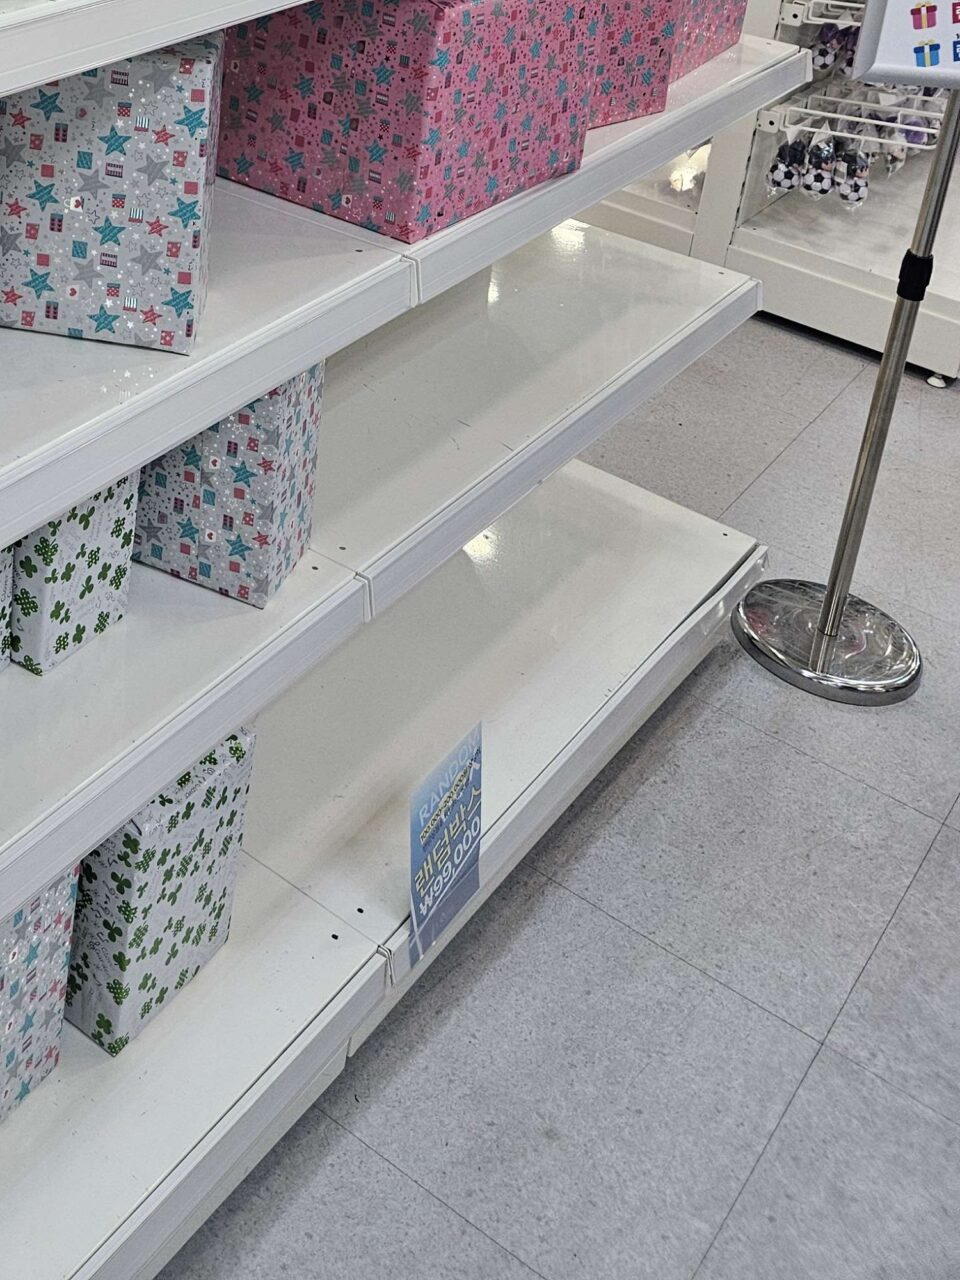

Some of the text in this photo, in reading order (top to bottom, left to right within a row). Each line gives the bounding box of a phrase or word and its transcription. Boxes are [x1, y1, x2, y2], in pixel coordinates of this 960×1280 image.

[419, 727, 480, 828] RANDOM
[415, 785, 480, 897] 랜덤박스
[419, 816, 480, 916] ₩99,000
